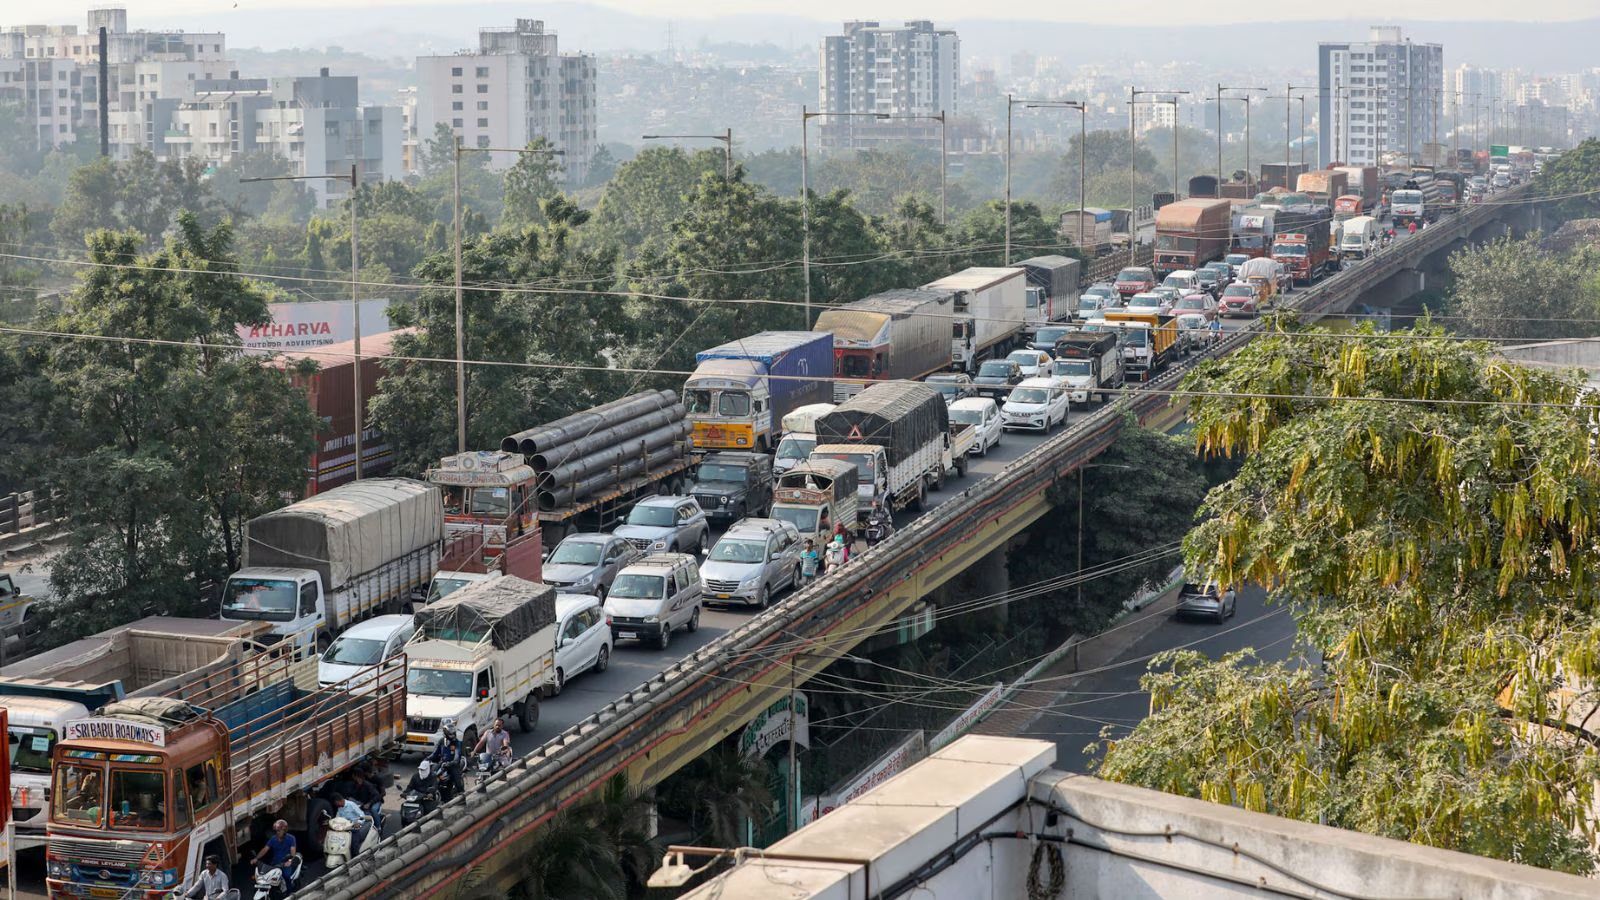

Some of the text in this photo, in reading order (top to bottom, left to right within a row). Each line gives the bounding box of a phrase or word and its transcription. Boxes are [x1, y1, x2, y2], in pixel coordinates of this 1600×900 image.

[286, 338, 334, 347] ADVERTISING
[75, 722, 154, 743] SRI BABU ROADWAYS
